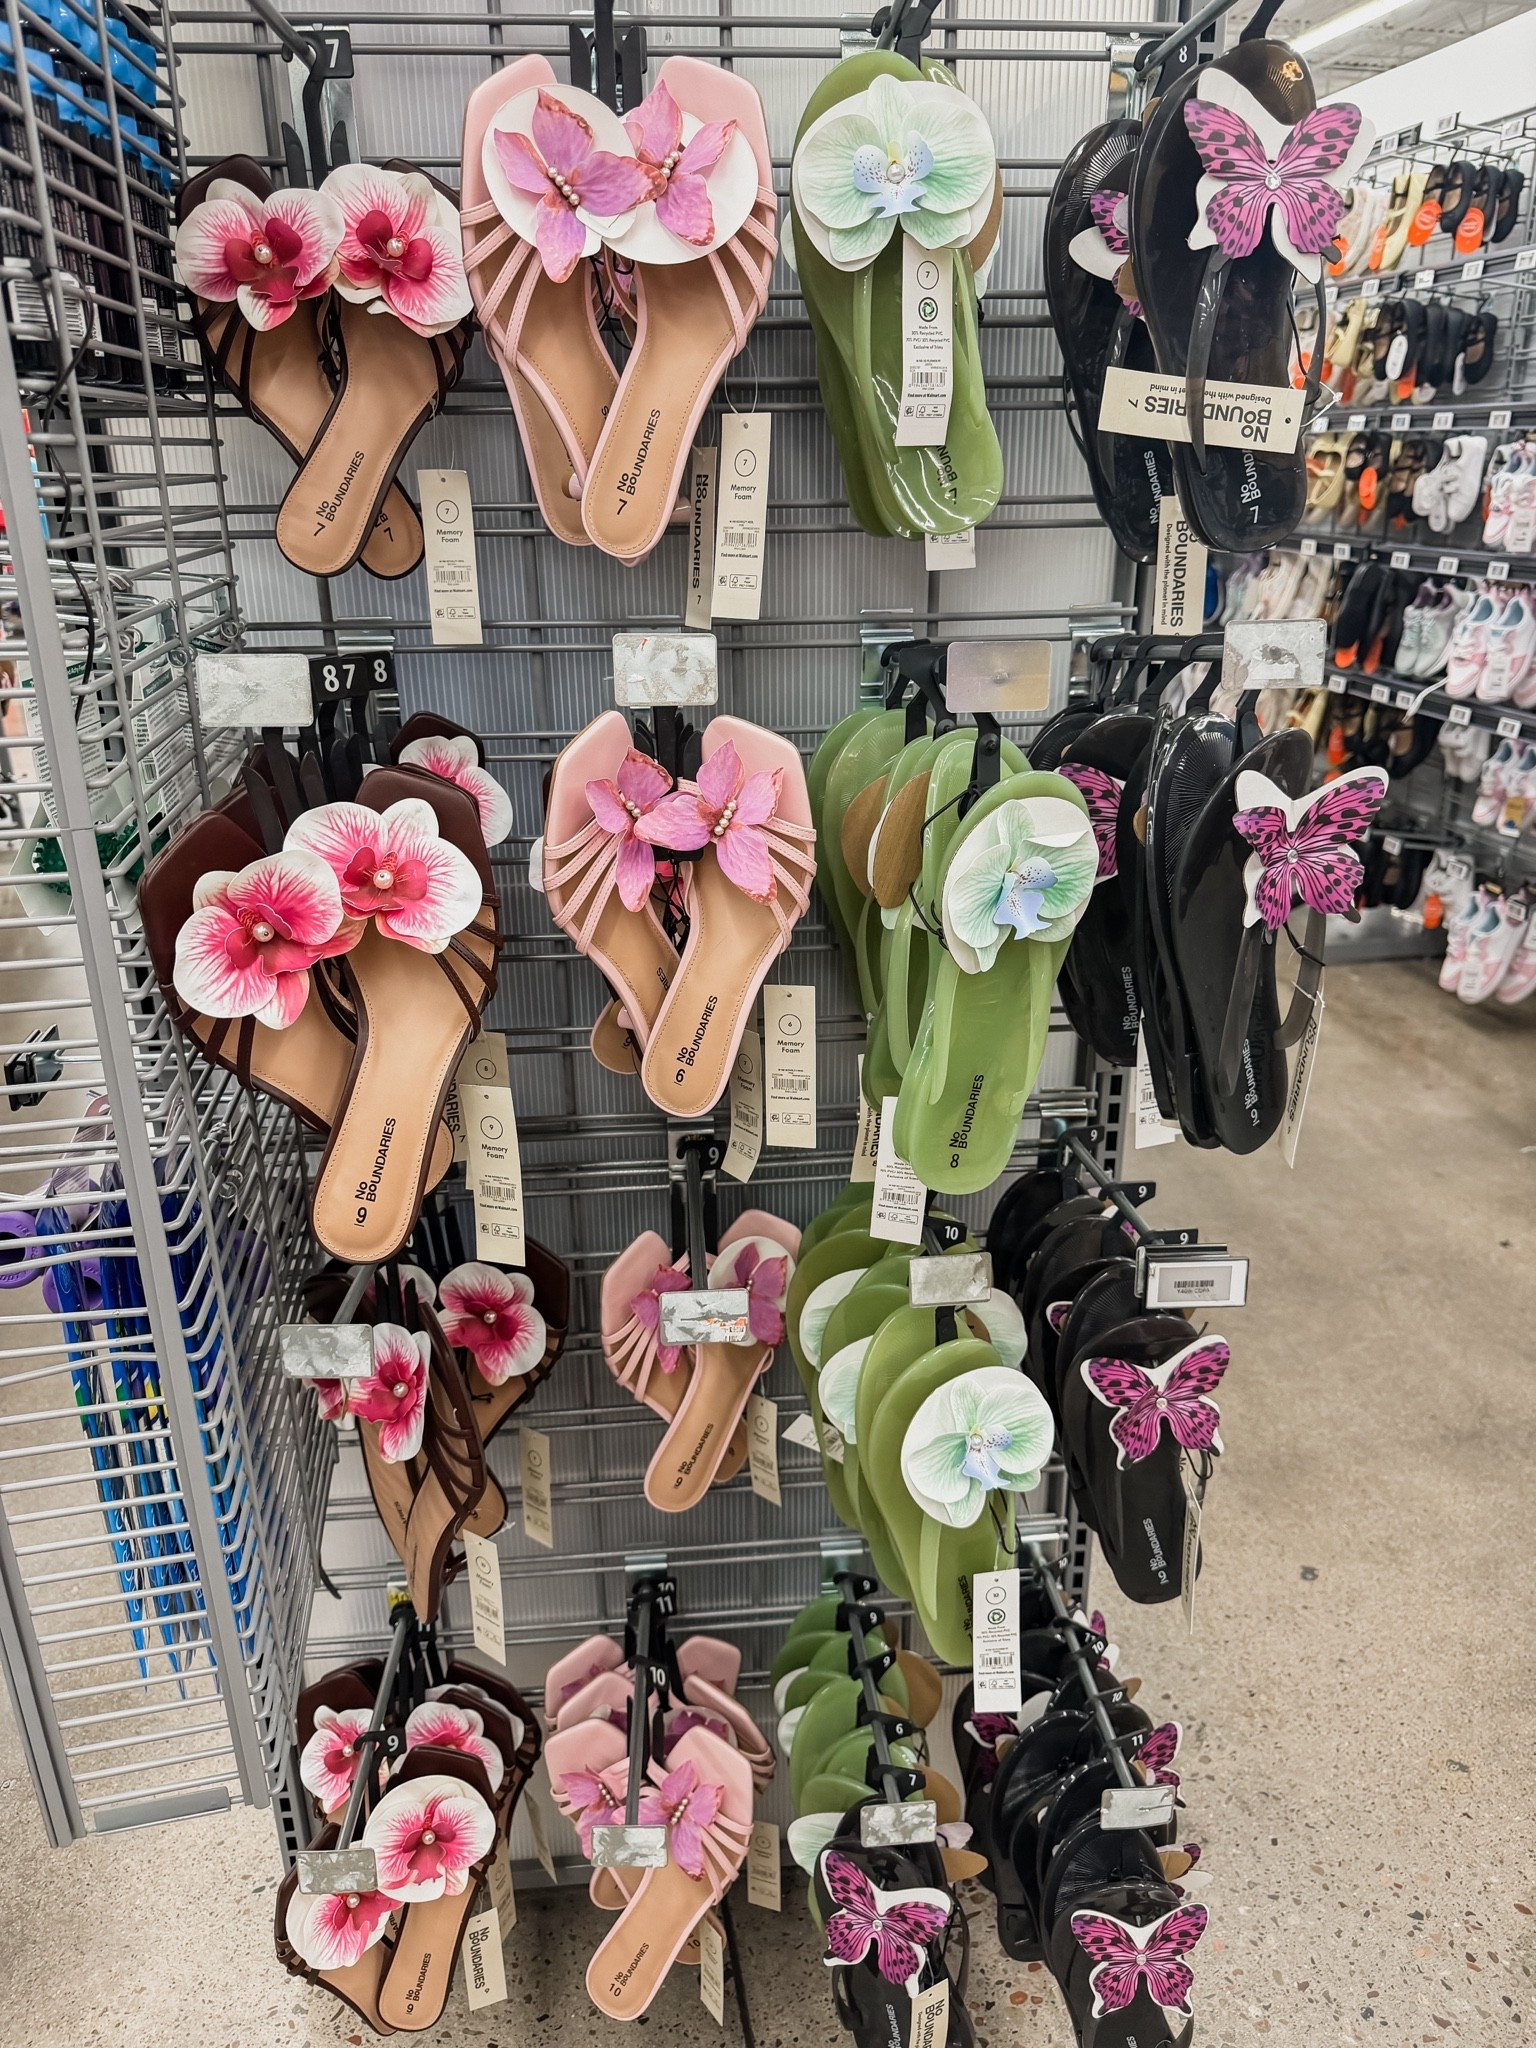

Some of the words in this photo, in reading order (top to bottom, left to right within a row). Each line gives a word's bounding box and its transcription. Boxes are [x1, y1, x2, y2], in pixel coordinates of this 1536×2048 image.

[324, 38, 340, 69] 7
[1179, 44, 1188, 63] 8
[925, 270, 930, 279] 7
[1149, 383, 1168, 392] mind
[1204, 390, 1216, 399] the
[1215, 391, 1234, 401] with
[1234, 393, 1272, 405] Designed
[1144, 396, 1273, 426] BOUNDRIES
[1241, 424, 1269, 443] NO
[626, 408, 661, 496] BOUNDARIES
[325, 451, 365, 523] BOUNDARIES
[616, 473, 629, 492] NO
[702, 474, 709, 499] NO
[731, 484, 757, 493] Memory
[1240, 484, 1252, 504] NO
[315, 500, 330, 518] NO
[444, 507, 450, 515] 7
[616, 498, 628, 516] 7
[1249, 505, 1259, 524] 7
[1149, 507, 1159, 525] NO
[313, 522, 326, 537] 7
[383, 527, 394, 542] 7
[436, 529, 464, 538] Memory
[692, 474, 703, 589] BOUNDARIES
[1164, 523, 1173, 554] Designed
[1170, 520, 1189, 627] BOUNDARIES
[1161, 580, 1169, 601] planet
[322, 664, 340, 692] 8
[341, 663, 356, 689] 7
[373, 659, 388, 683] 8
[1121, 966, 1140, 1029] BOUNDARIES
[1122, 1015, 1132, 1030] NO
[685, 995, 718, 1067] BOUNDARIES
[1129, 1032, 1138, 1046] 7
[777, 1040, 805, 1048] Memory
[676, 1047, 689, 1063] NO
[675, 1068, 686, 1084] 6
[1242, 1038, 1258, 1104] BOUNDARIES
[957, 1074, 985, 1149] BOUNDARIES
[949, 1131, 960, 1148] NO
[1090, 1130, 1098, 1141] 9
[481, 1144, 508, 1154] Memory
[486, 1151, 505, 1160] Foam
[708, 1146, 720, 1165] 9
[366, 1117, 397, 1203] BOUNDARIES
[950, 1153, 960, 1169] 8
[354, 1181, 368, 1201] NO
[1138, 1185, 1147, 1198] 9
[355, 1206, 367, 1225] 9
[944, 1225, 959, 1241] 10
[1179, 1232, 1189, 1245] 9
[684, 1423, 714, 1475] BOUNDARIES
[677, 1461, 688, 1473] NO
[1143, 1517, 1167, 1568] BOUNDARIES
[1058, 1557, 1068, 1568] 10
[863, 1580, 871, 1591] 9
[655, 1595, 673, 1614] 11
[869, 1612, 878, 1623] 9
[1092, 1641, 1104, 1653] 10
[883, 1655, 891, 1667] 9
[649, 1666, 666, 1686] 10
[1112, 1691, 1123, 1703] 10
[896, 1723, 904, 1735] 6
[386, 1736, 399, 1752] 9
[1132, 1734, 1144, 1746] 11
[909, 1774, 917, 1786] 7
[480, 1926, 490, 1942] NO
[687, 1939, 700, 1950] 10
[469, 1930, 485, 1990] BOUNDARIES
[620, 1942, 650, 1987] BOUNDARIES
[413, 1953, 432, 2002] BOUNDARIES
[614, 1971, 624, 1983] NO
[405, 1989, 414, 2001] NO
[609, 1983, 621, 1997] 10
[935, 1999, 945, 2016] NO
